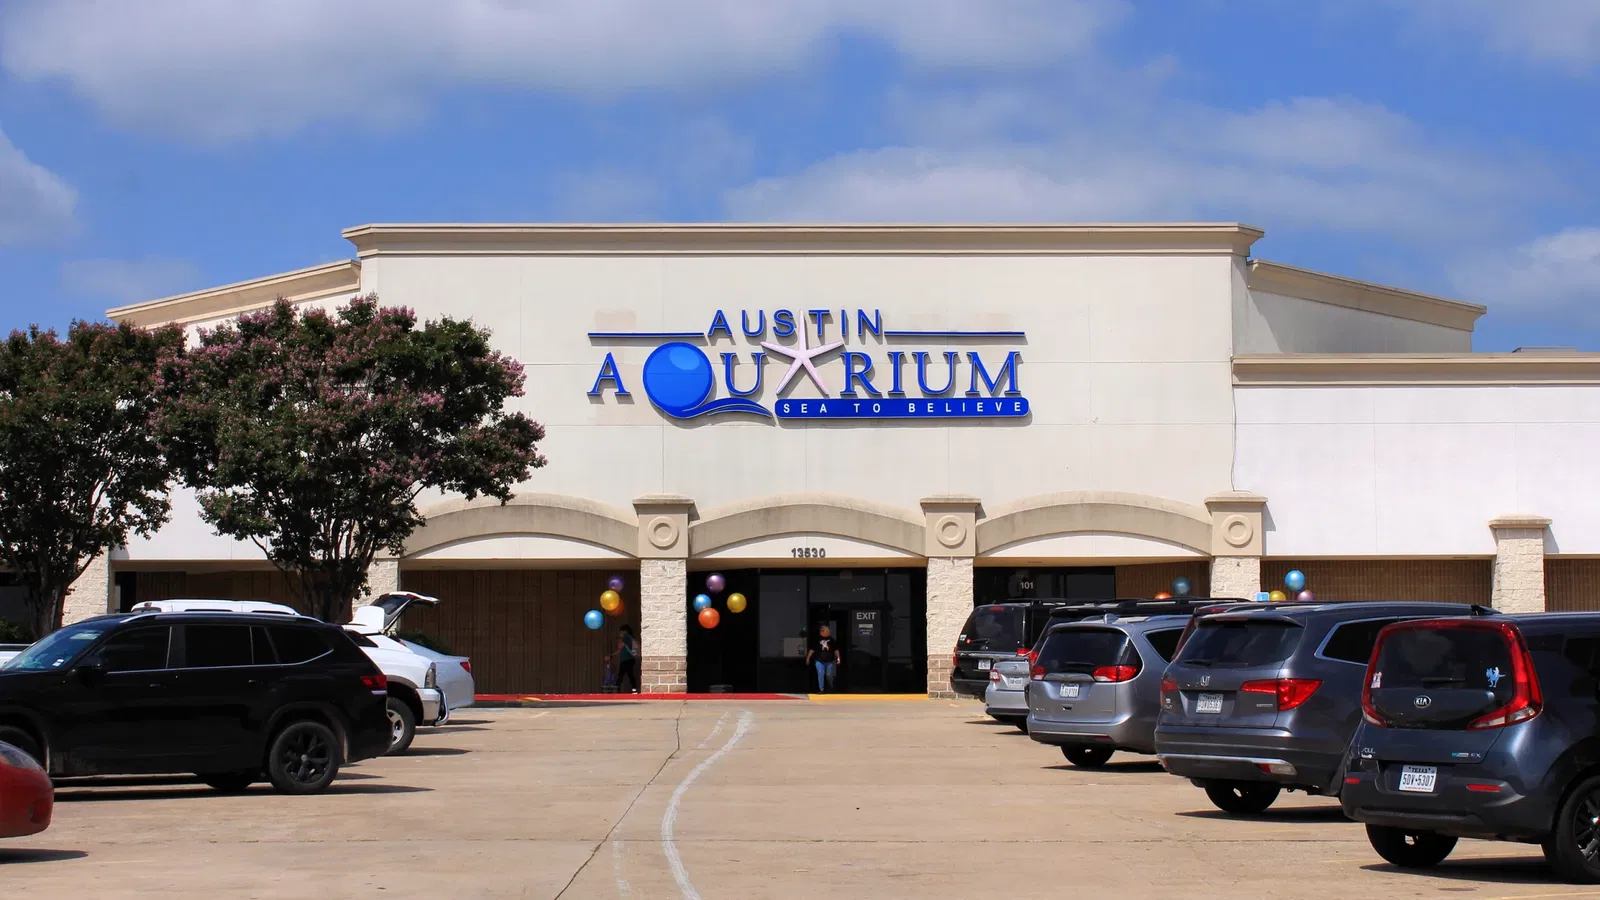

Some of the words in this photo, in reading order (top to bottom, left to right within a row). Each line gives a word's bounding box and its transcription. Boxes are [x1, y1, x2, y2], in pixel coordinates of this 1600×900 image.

[707, 309, 881, 336] AUSTIN
[783, 403, 827, 414] SEA
[854, 402, 881, 413] TO
[908, 401, 1021, 413] BELIEVE
[1020, 581, 1034, 589] 101
[856, 612, 877, 620] EXIT
